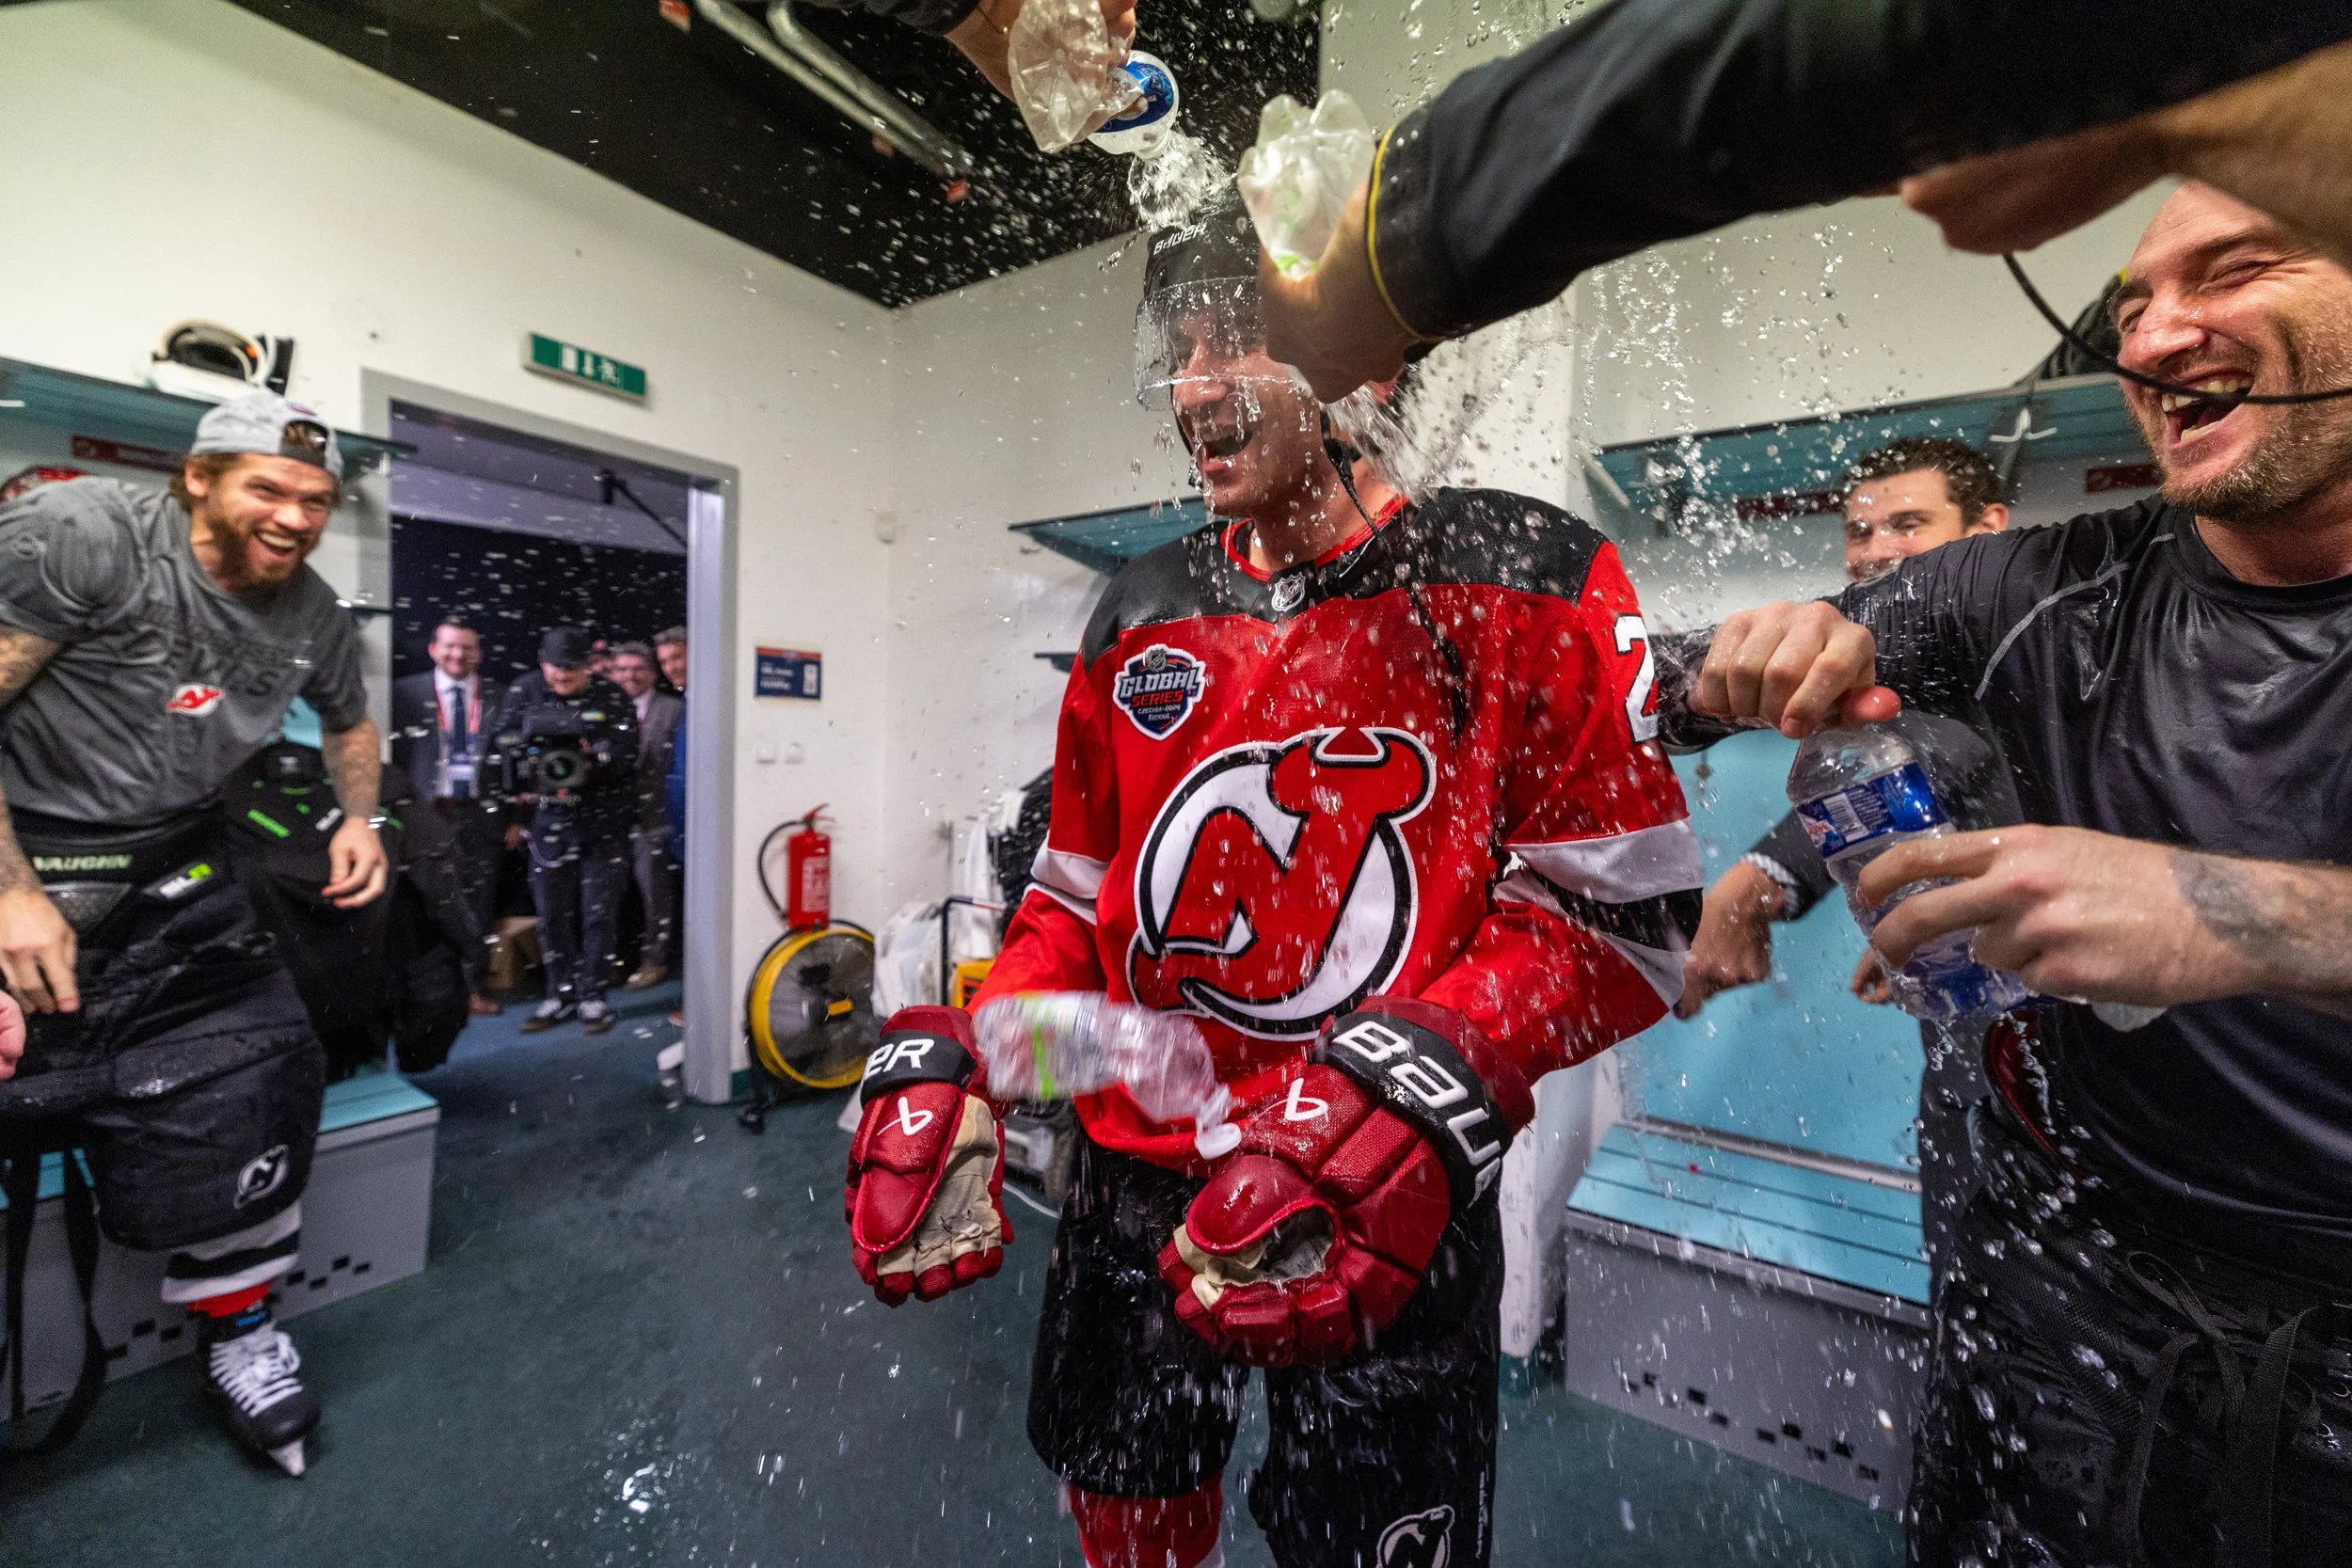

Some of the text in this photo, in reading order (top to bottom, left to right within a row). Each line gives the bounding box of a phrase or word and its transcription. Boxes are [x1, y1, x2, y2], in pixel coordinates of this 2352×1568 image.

[1153, 222, 1207, 256] BAUER
[1120, 667, 1199, 699] GLOBAL
[1132, 689, 1184, 708] SERIES
[32, 854, 133, 872] VAUGHN
